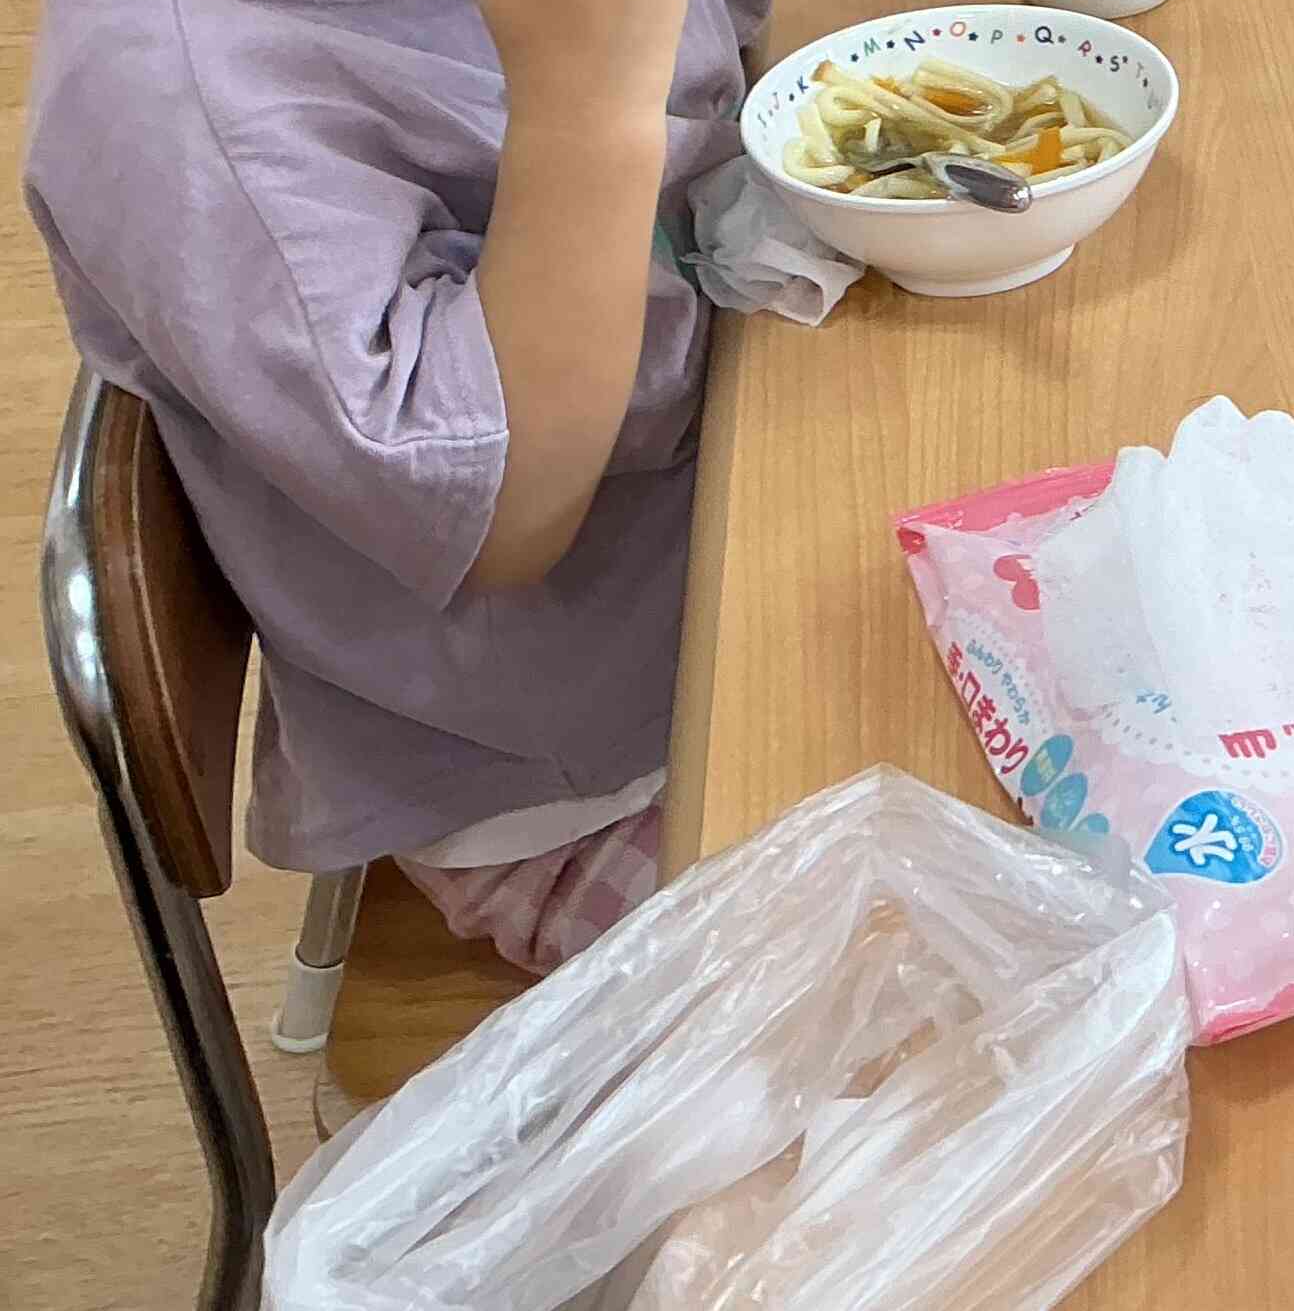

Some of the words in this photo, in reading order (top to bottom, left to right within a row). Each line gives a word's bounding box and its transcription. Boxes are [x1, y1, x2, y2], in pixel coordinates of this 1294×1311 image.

[797, 75, 809, 94] K
[863, 37, 881, 57] M
[904, 30, 926, 52] N
[949, 21, 967, 38] O
[991, 29, 1004, 45] P
[1035, 25, 1055, 44] Q
[1077, 40, 1092, 57] R
[1109, 55, 1121, 72] S
[1171, 813, 1238, 866] 水
